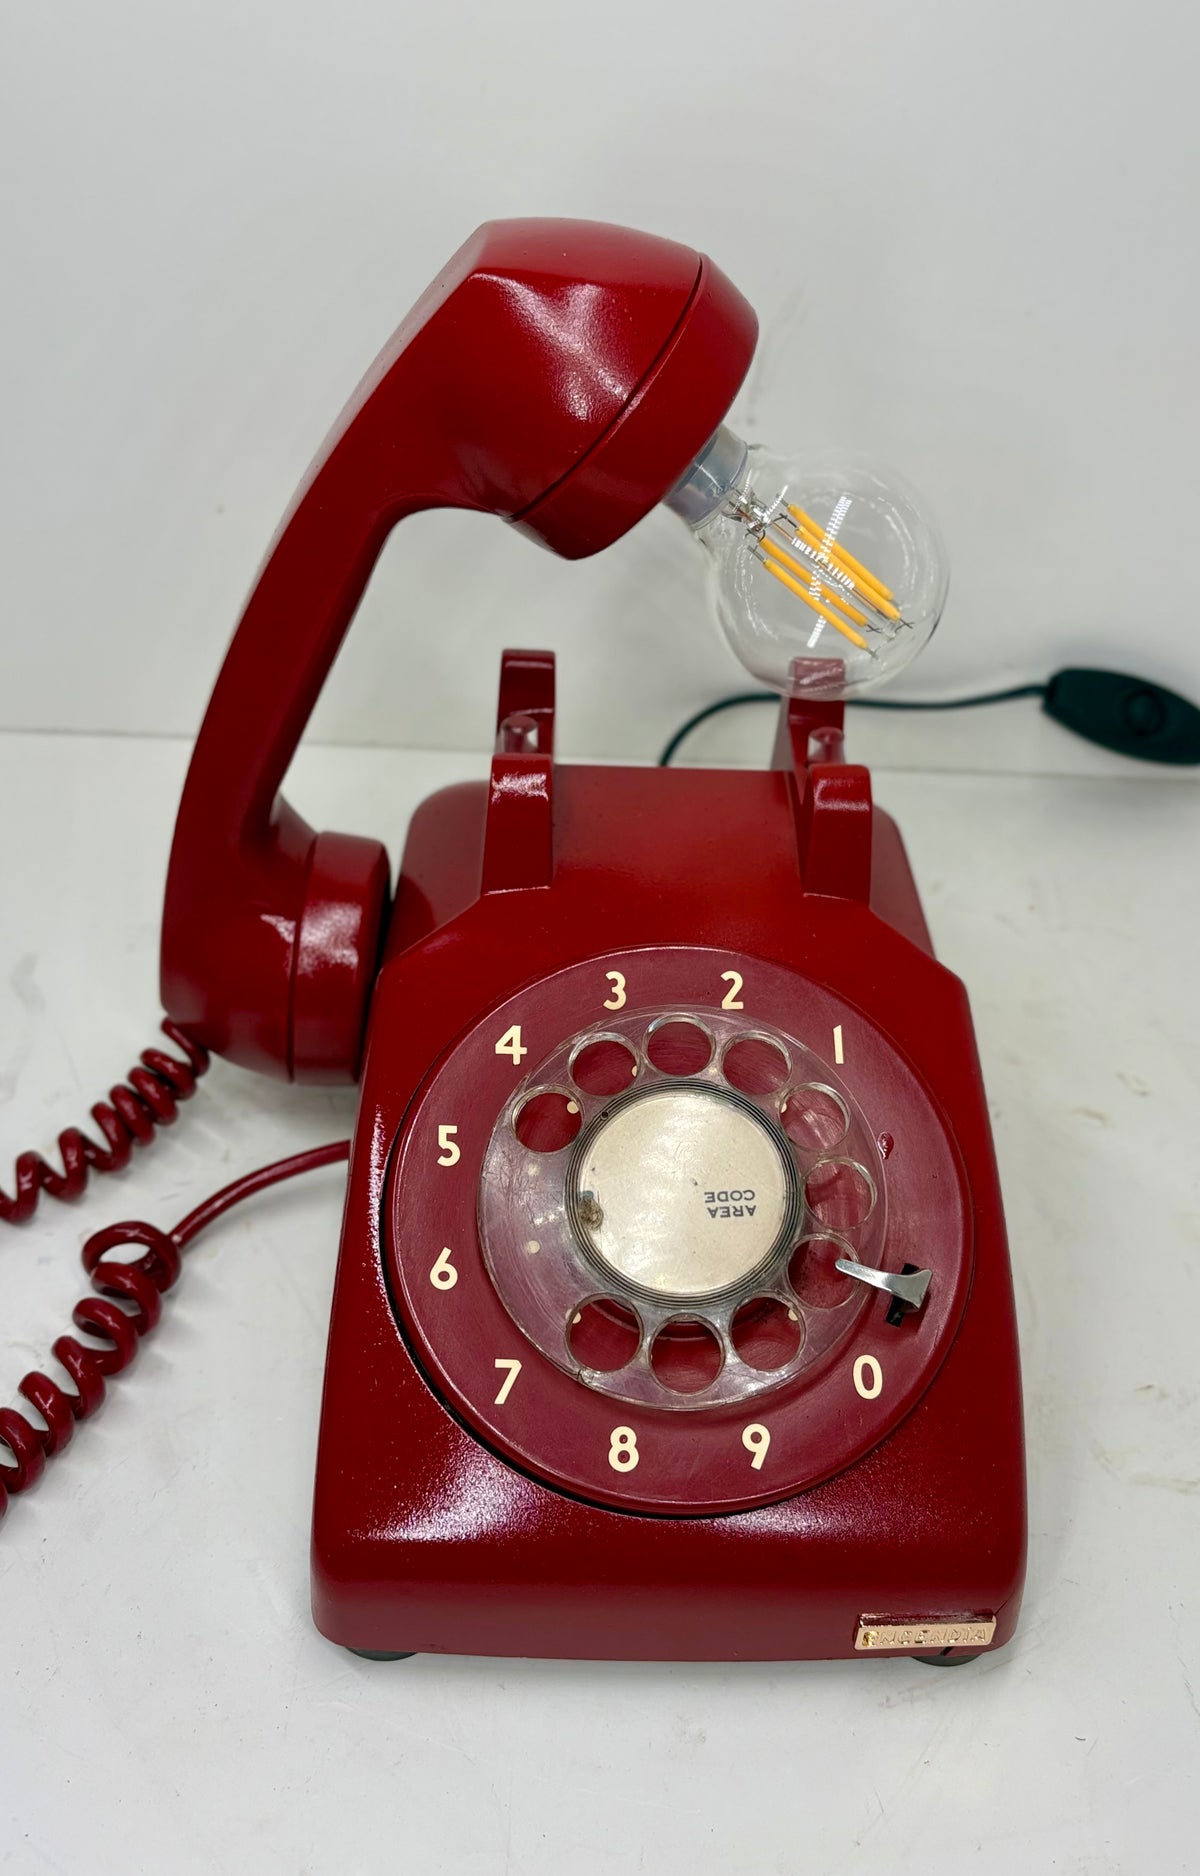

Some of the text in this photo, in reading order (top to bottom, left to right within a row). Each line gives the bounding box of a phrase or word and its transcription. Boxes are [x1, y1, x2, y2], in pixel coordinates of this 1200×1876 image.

[603, 970, 627, 1011] 3
[720, 970, 744, 1010] 2
[494, 1024, 528, 1066] 4
[832, 1024, 845, 1065] 1
[436, 1124, 461, 1168] 5
[704, 1189, 756, 1203] CODE
[706, 1205, 757, 1218] AREA
[429, 1246, 459, 1291] 6
[494, 1358, 523, 1405] 7
[852, 1354, 884, 1400] 0
[608, 1425, 640, 1473] 8
[741, 1423, 772, 1470] 9
